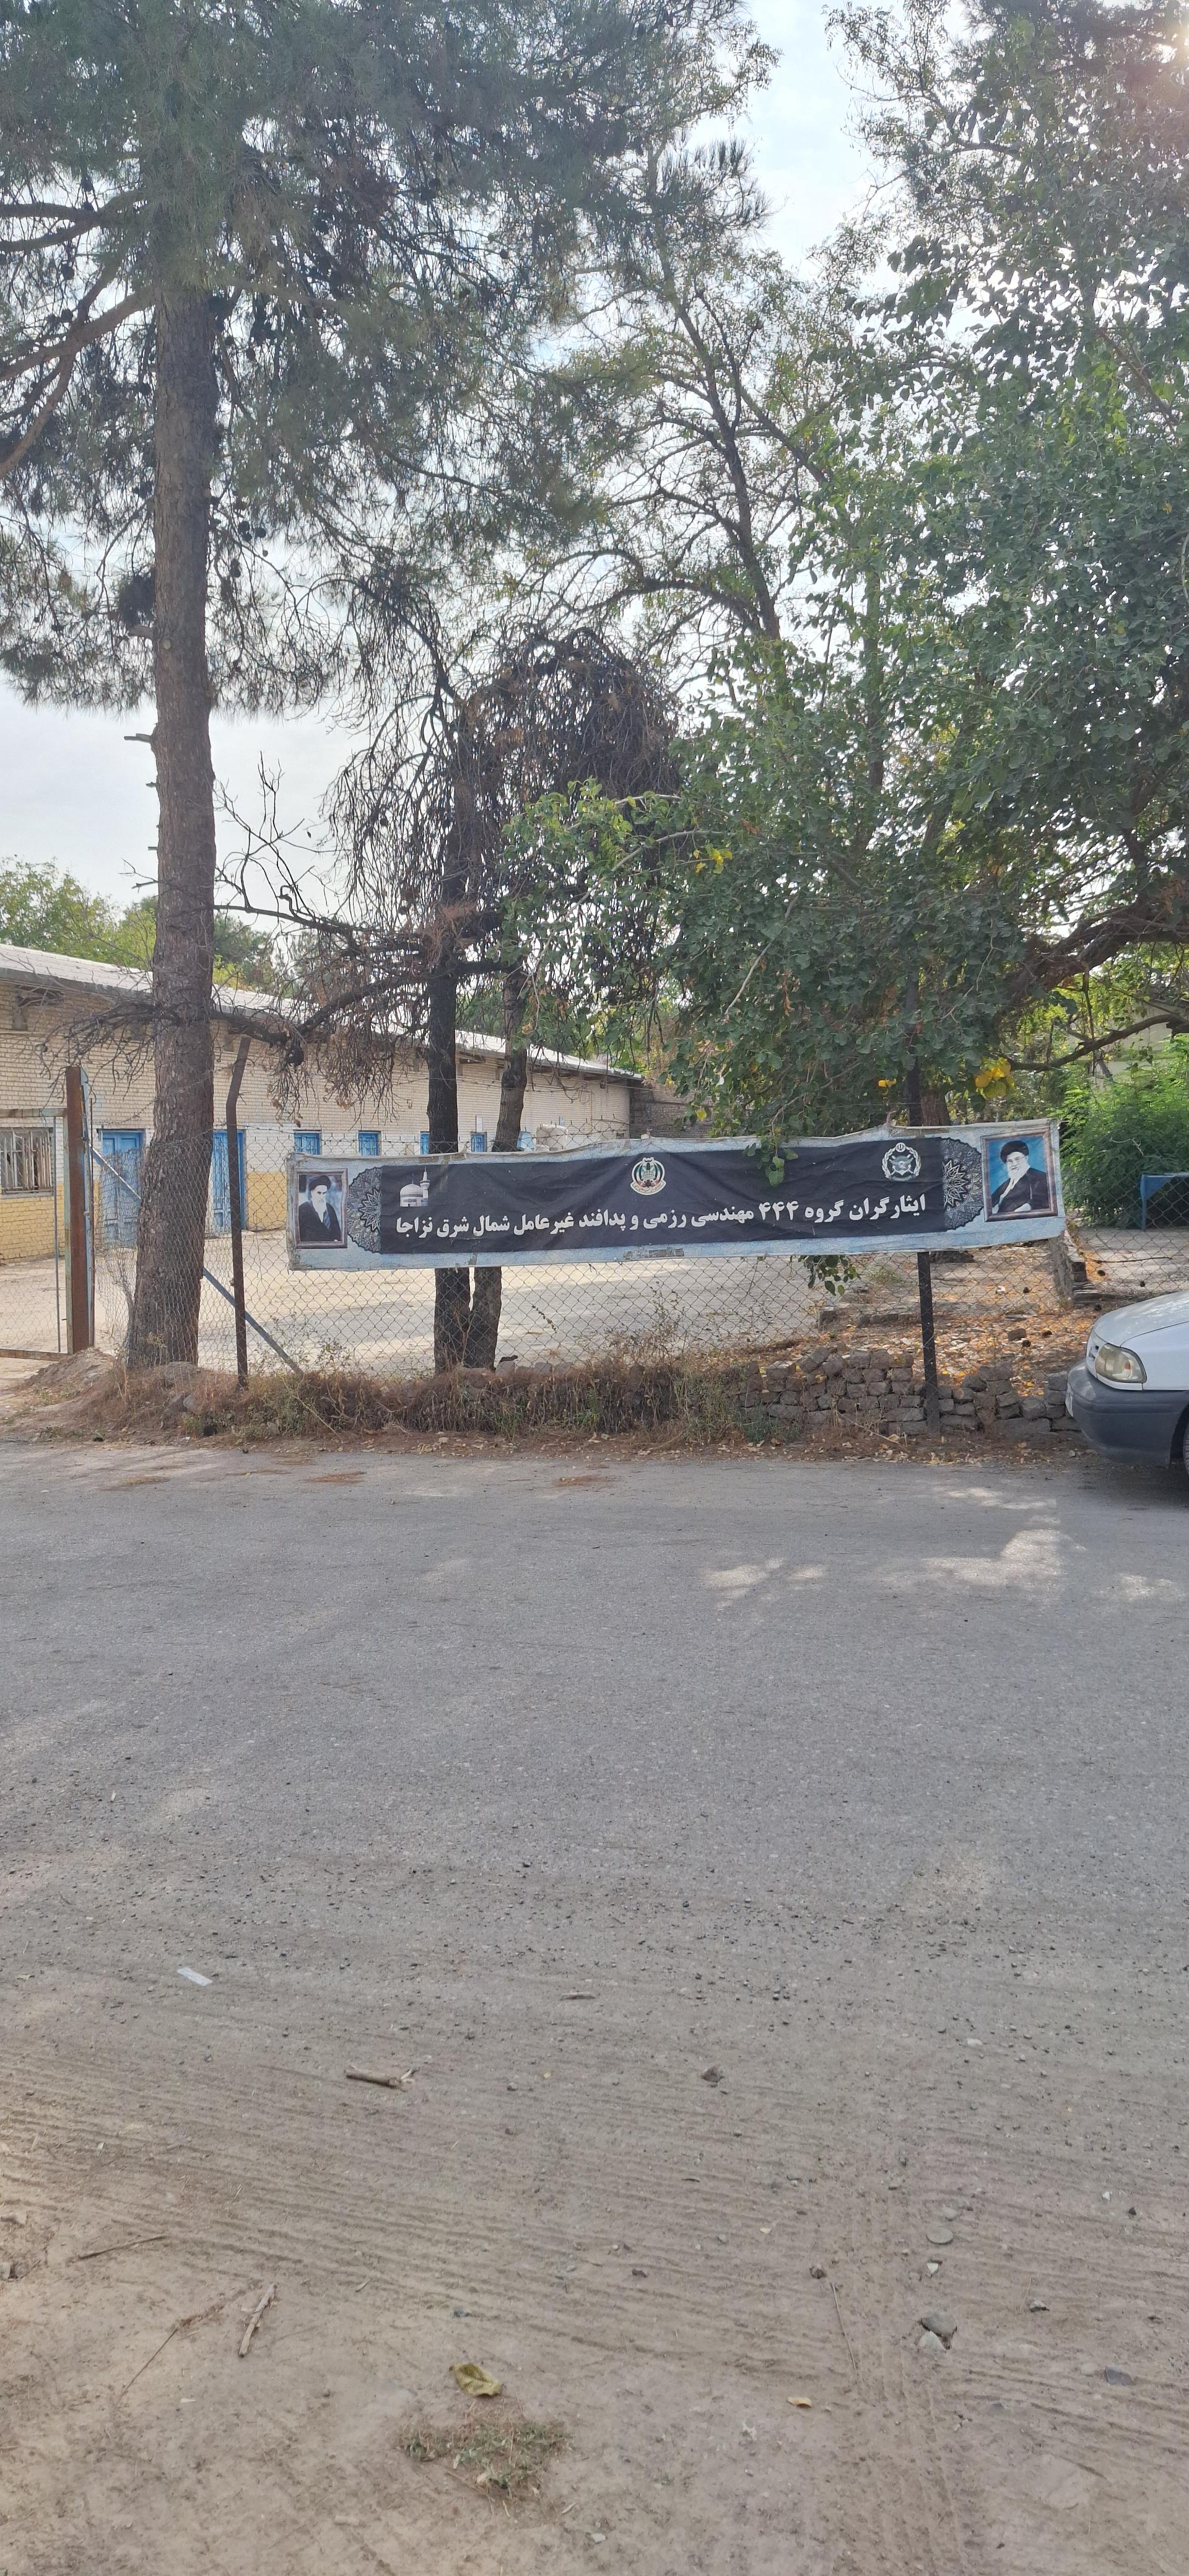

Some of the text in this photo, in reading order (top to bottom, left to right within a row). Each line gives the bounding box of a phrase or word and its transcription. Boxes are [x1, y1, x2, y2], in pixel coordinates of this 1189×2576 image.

[691, 1206, 754, 1227] مهندسی
[758, 1201, 799, 1220] ۴۴۴
[804, 1199, 844, 1223] گروه
[848, 1193, 926, 1220] ایثارگران
[396, 1217, 433, 1238] نزاجا
[437, 1216, 469, 1238] شرق
[473, 1215, 510, 1237] شمال
[578, 1209, 625, 1231] پدافند
[629, 1215, 639, 1230] و
[643, 1209, 687, 1229] رزمی
